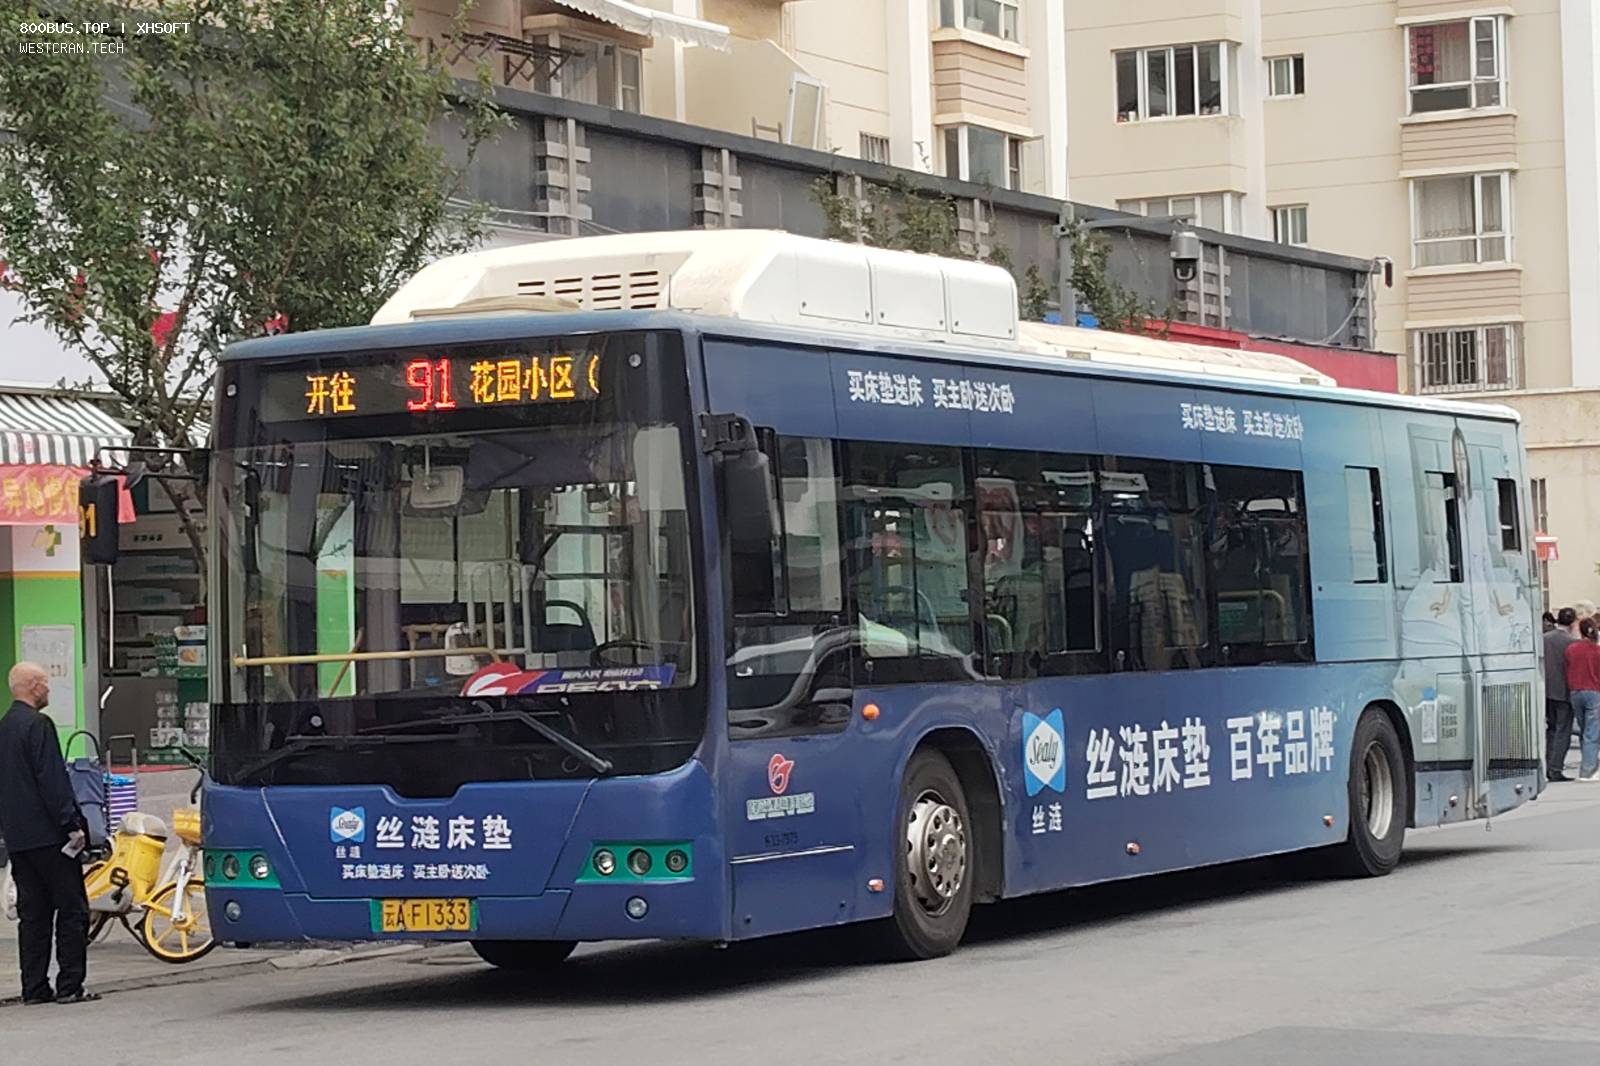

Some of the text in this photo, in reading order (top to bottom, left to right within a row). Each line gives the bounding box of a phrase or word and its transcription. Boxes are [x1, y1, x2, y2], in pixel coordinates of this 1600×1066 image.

[305, 371, 356, 414] 开往
[405, 358, 457, 411] 91
[847, 370, 1015, 414] 买床垫送床 买主卧送次卧
[1029, 736, 1059, 770] Sealy
[1086, 717, 1211, 799] 丝涟床垫
[1227, 706, 1334, 781] 百年品牌
[376, 814, 512, 850] 丝涟床垫
[1032, 802, 1062, 834] 丝涟
